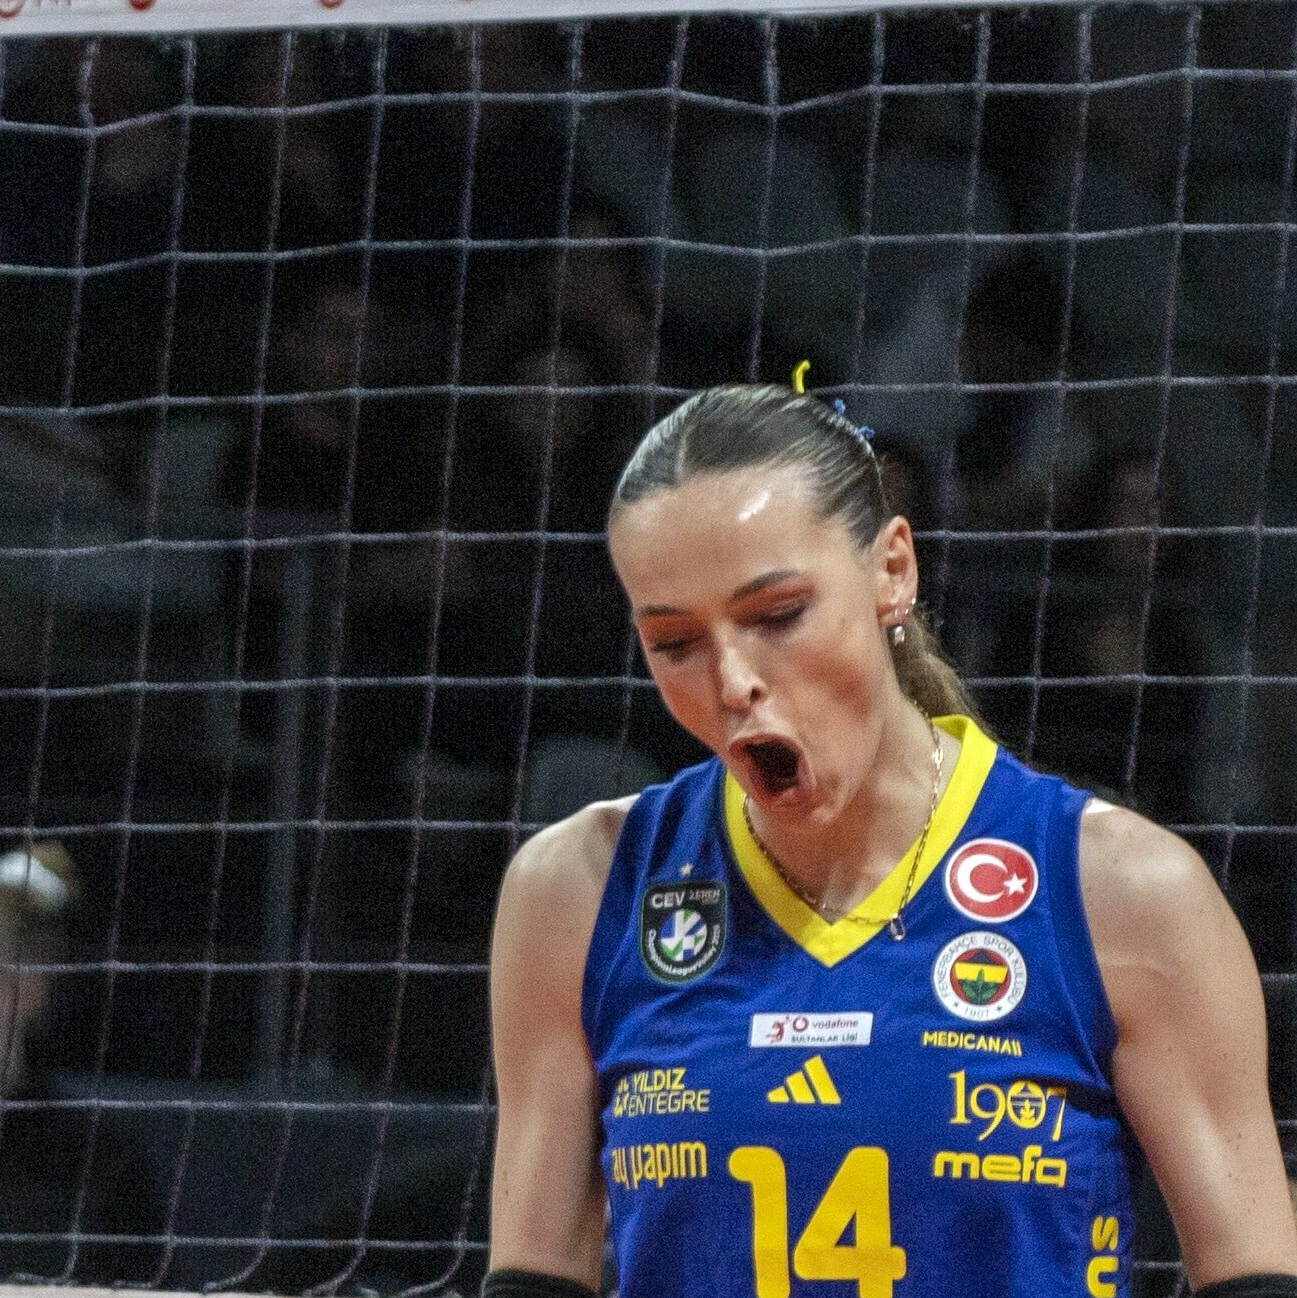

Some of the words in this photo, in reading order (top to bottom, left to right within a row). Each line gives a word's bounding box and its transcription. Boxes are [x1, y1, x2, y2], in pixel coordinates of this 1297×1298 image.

[652, 890, 685, 909] CEV
[632, 1067, 686, 1092] YILDIZ
[627, 1089, 711, 1117] ENTEGRE
[948, 1069, 1068, 1142] 1907
[933, 1144, 1068, 1188] mefa
